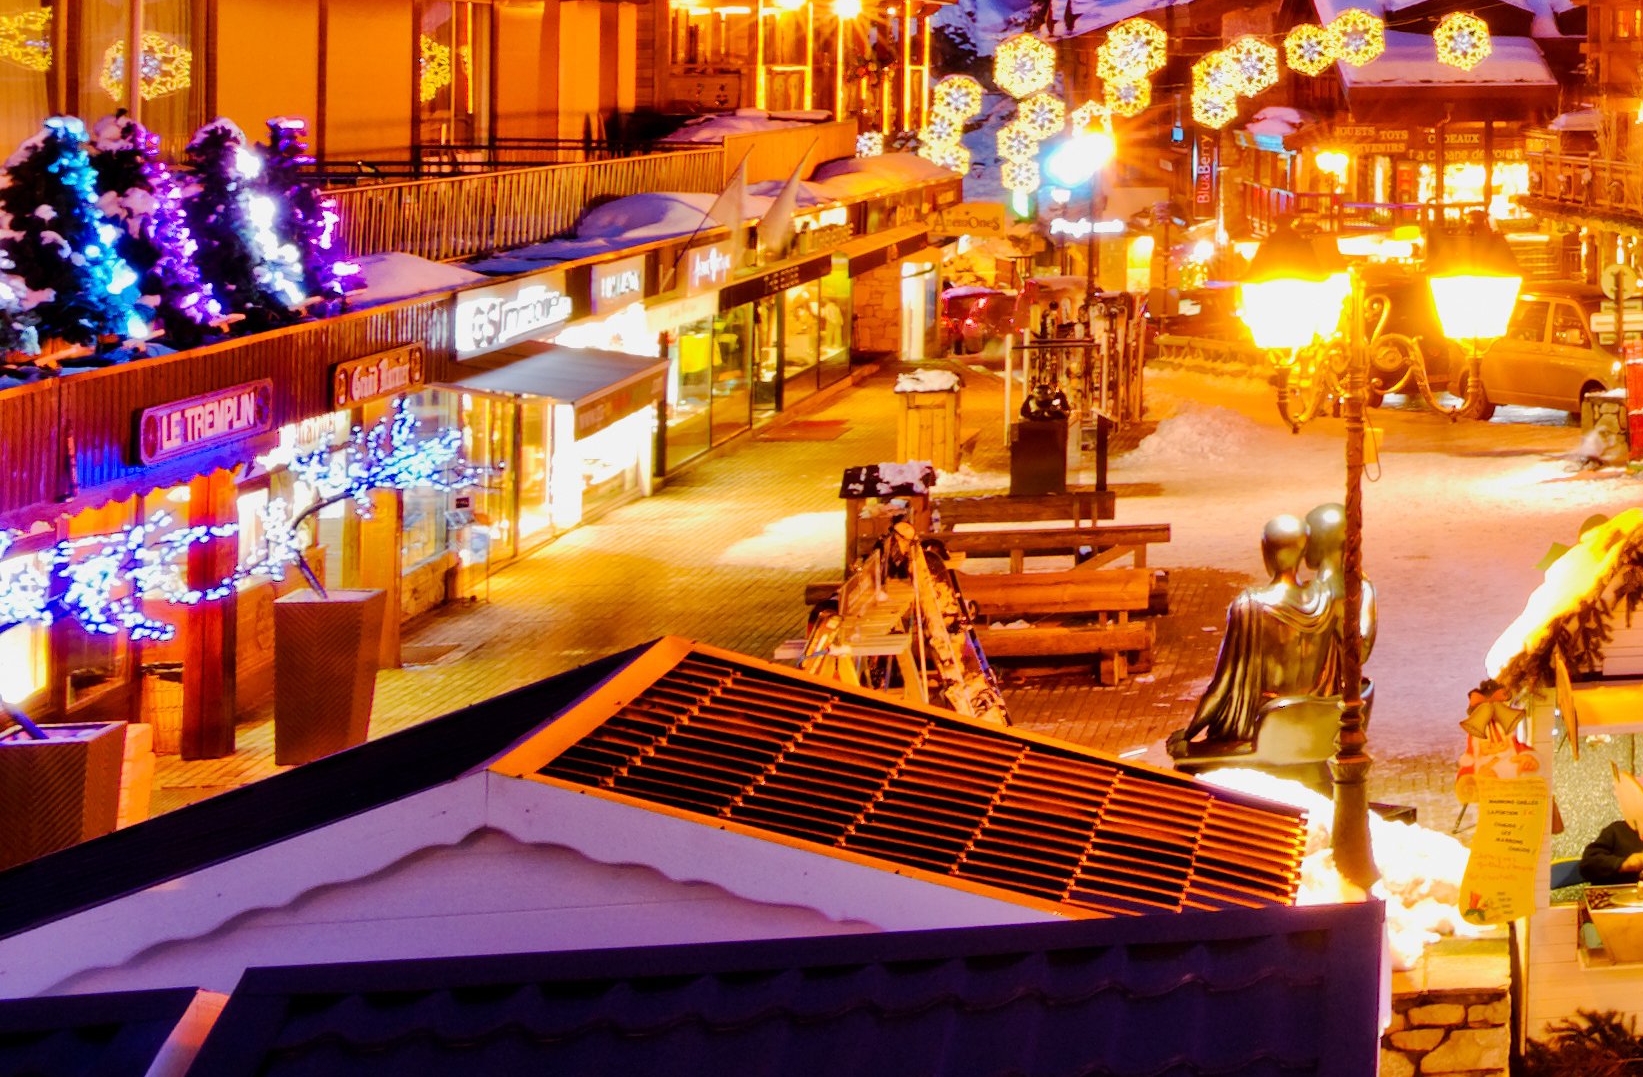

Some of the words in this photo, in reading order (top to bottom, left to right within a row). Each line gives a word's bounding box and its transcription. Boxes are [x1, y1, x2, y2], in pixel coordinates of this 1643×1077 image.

[1379, 129, 1409, 141] TOYS
[1427, 133, 1480, 145] CDEAUX
[1196, 134, 1214, 204] Blu&Berry
[161, 412, 182, 451] LE
[183, 391, 256, 443] TREMPLIN
